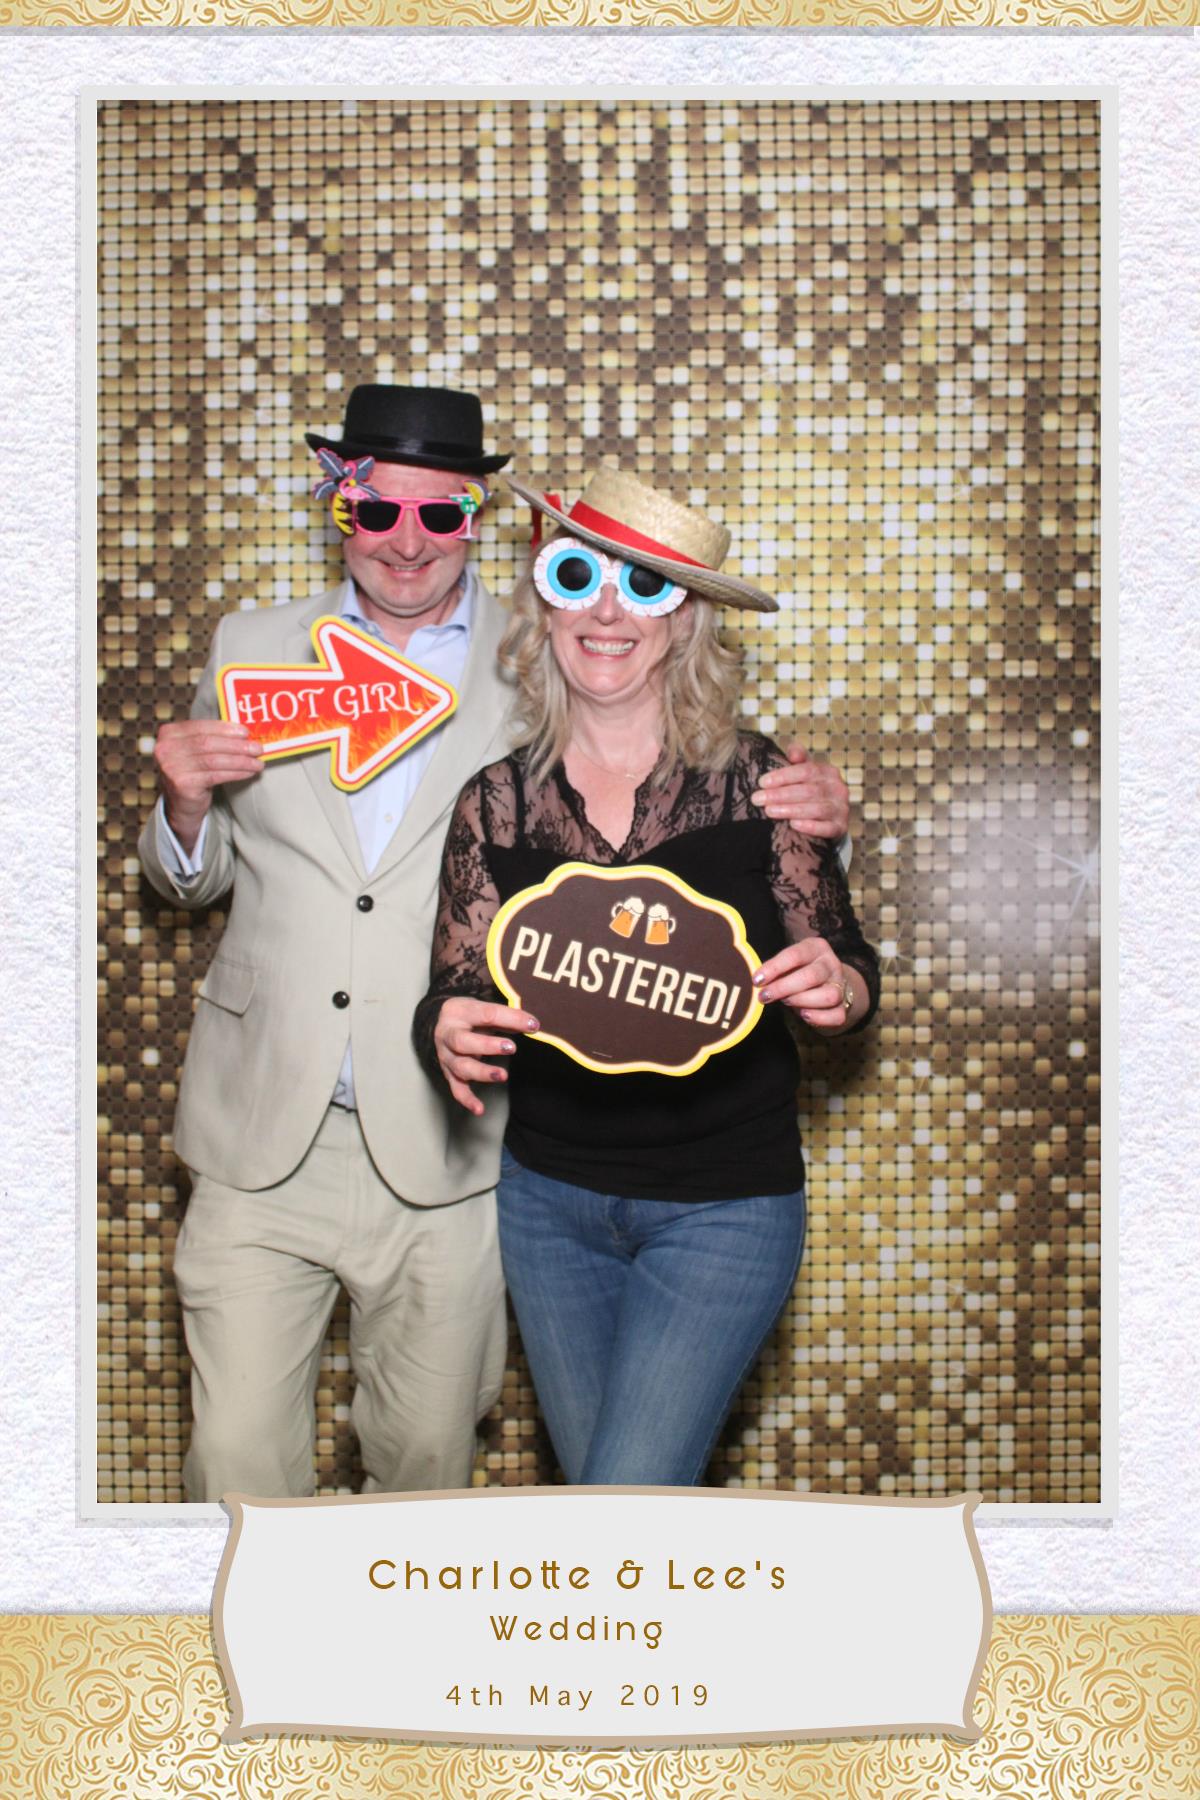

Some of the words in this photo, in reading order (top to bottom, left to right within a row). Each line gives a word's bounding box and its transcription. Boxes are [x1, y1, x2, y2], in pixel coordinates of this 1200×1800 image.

[238, 687, 325, 724] HOT
[333, 680, 423, 721] GIRL
[508, 926, 741, 1030] PLASTERED!
